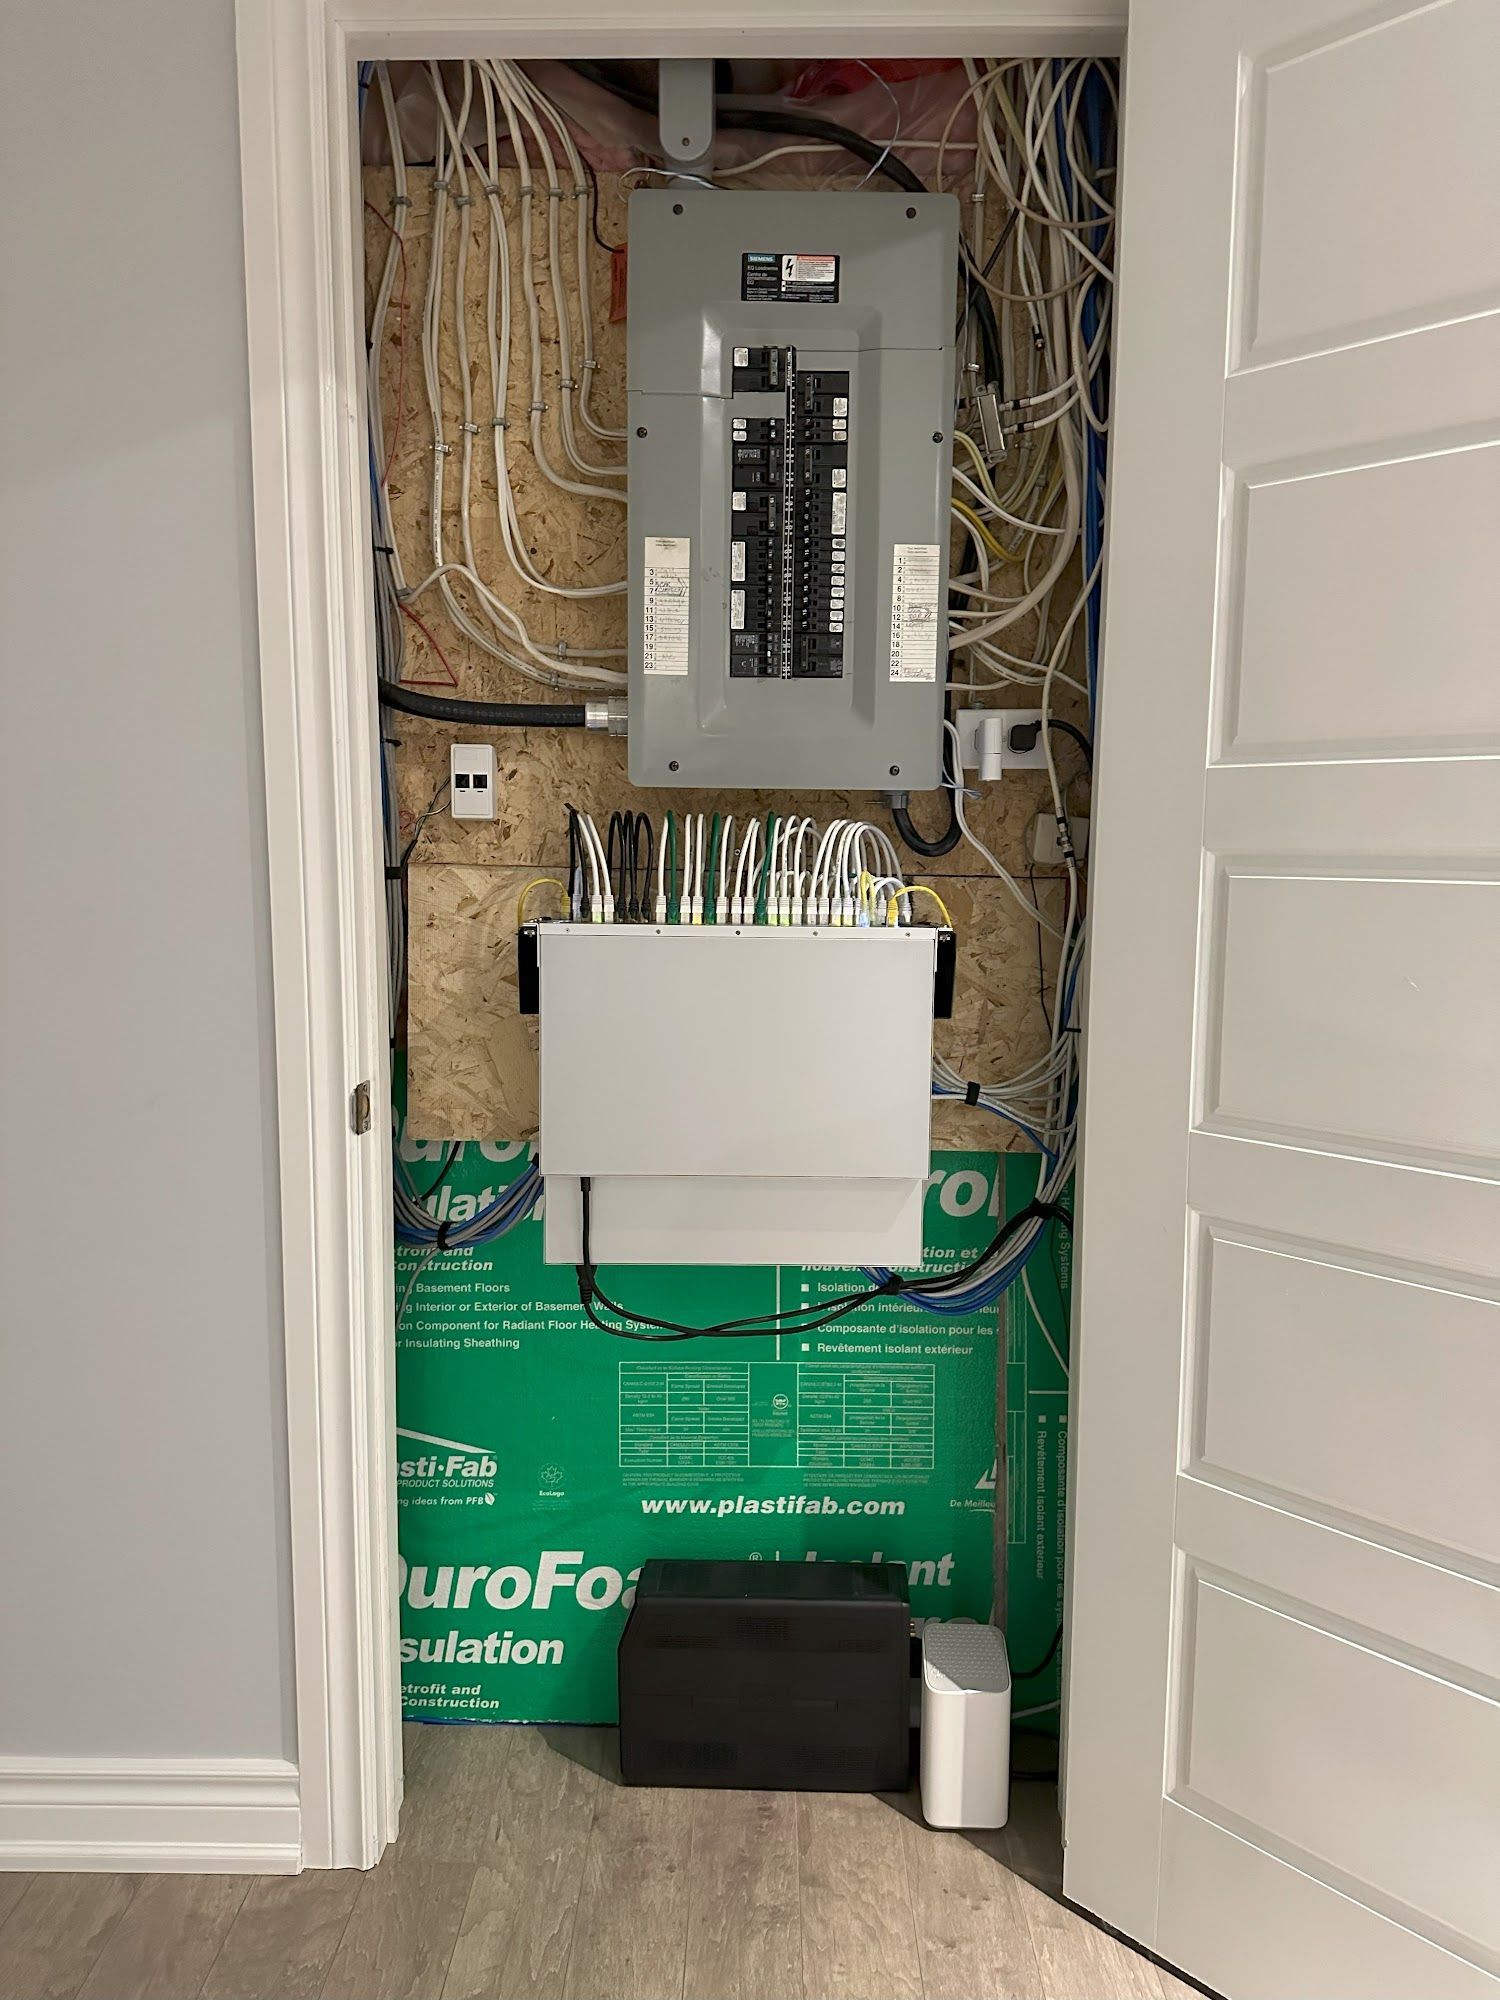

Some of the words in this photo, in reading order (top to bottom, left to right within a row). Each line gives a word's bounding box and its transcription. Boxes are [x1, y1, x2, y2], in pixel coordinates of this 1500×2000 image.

[923, 1247, 955, 1259] tion
[960, 1248, 978, 1259] et
[1058, 1241, 1071, 1289] Systems
[416, 1283, 472, 1293] Basement
[475, 1283, 510, 1293] Floors
[817, 1283, 865, 1293] Isolation
[416, 1302, 456, 1312] Interior
[459, 1304, 471, 1312] or
[474, 1302, 517, 1312] Exterior
[521, 1301, 532, 1311] of
[416, 1320, 481, 1332] Component
[484, 1320, 499, 1330] for
[502, 1320, 545, 1330] Radiant
[548, 1320, 576, 1330] Floor
[817, 1324, 887, 1335] Composante
[889, 1324, 946, 1335] d'isolation
[949, 1326, 974, 1336] pour
[977, 1327, 993, 1335] les
[406, 1338, 461, 1350] Insulating
[464, 1338, 520, 1350] Sheathing
[817, 1343, 882, 1353] Revêtement
[885, 1344, 922, 1354] isolant
[924, 1344, 973, 1355] extérieur
[1055, 1430, 1067, 1497] Composante
[397, 1479, 440, 1488] PRODUCT
[442, 1479, 495, 1488] SOLUTIONS
[539, 1490, 565, 1498] EcoLogo
[397, 1498, 409, 1507] ng
[412, 1496, 438, 1505] ideas
[440, 1496, 463, 1505] from
[466, 1496, 484, 1505] PFB
[641, 1495, 906, 1517] www.plastifab.com
[950, 1499, 962, 1507] De
[1036, 1496, 1047, 1531] isolant
[1055, 1557, 1064, 1580] pour
[400, 1631, 564, 1664] sulation
[400, 1684, 446, 1694] etrofit
[452, 1685, 481, 1695] and
[400, 1695, 500, 1709] Construction
